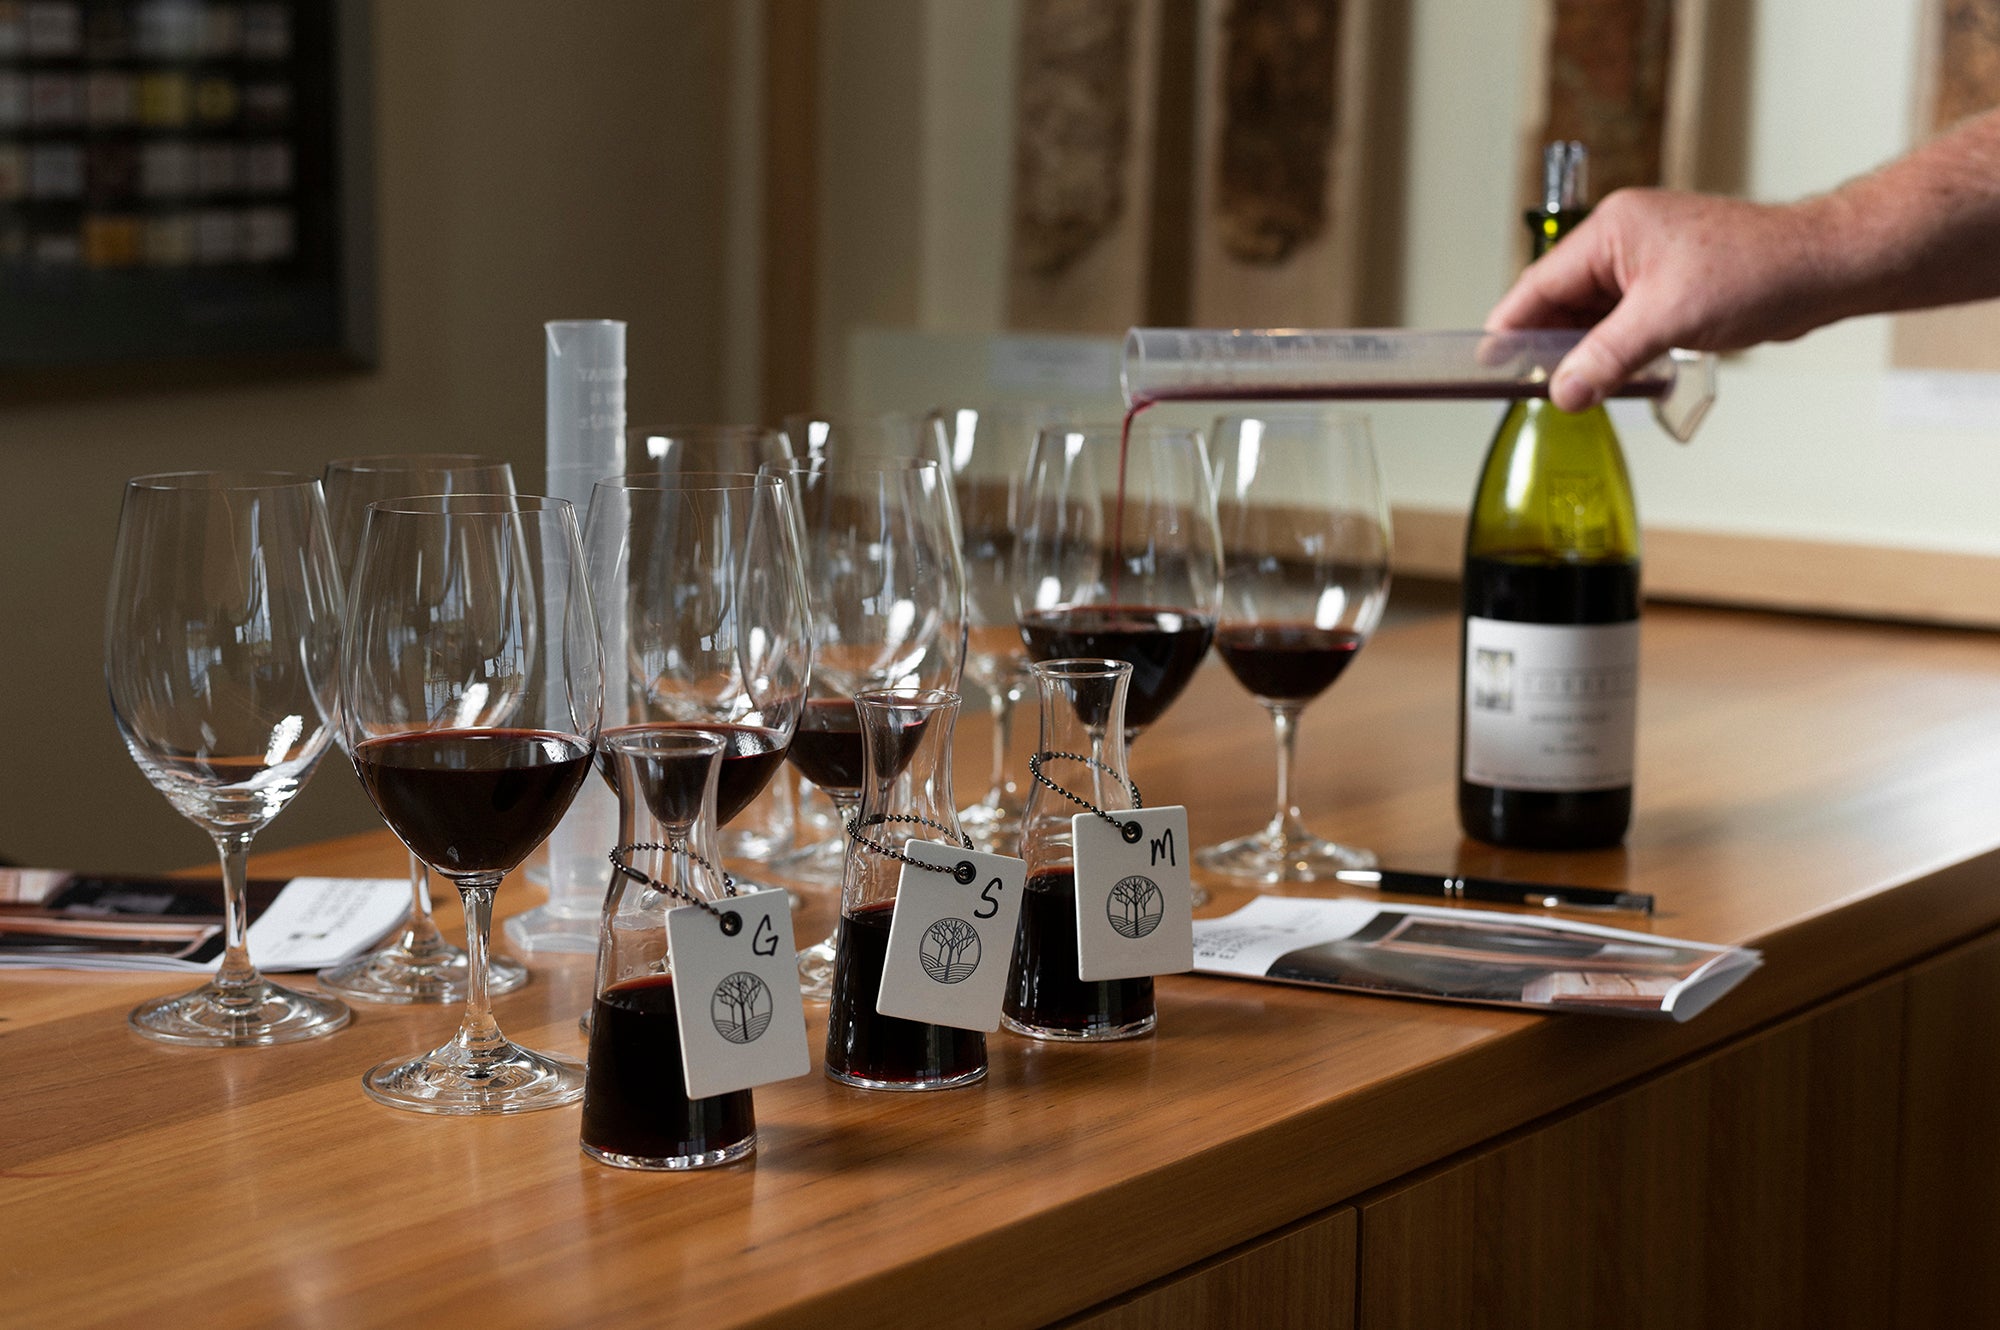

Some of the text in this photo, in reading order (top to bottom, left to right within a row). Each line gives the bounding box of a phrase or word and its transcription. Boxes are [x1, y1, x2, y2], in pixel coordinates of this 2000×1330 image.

[1149, 827, 1177, 868] M
[973, 876, 1003, 920] S
[751, 913, 780, 957] G
